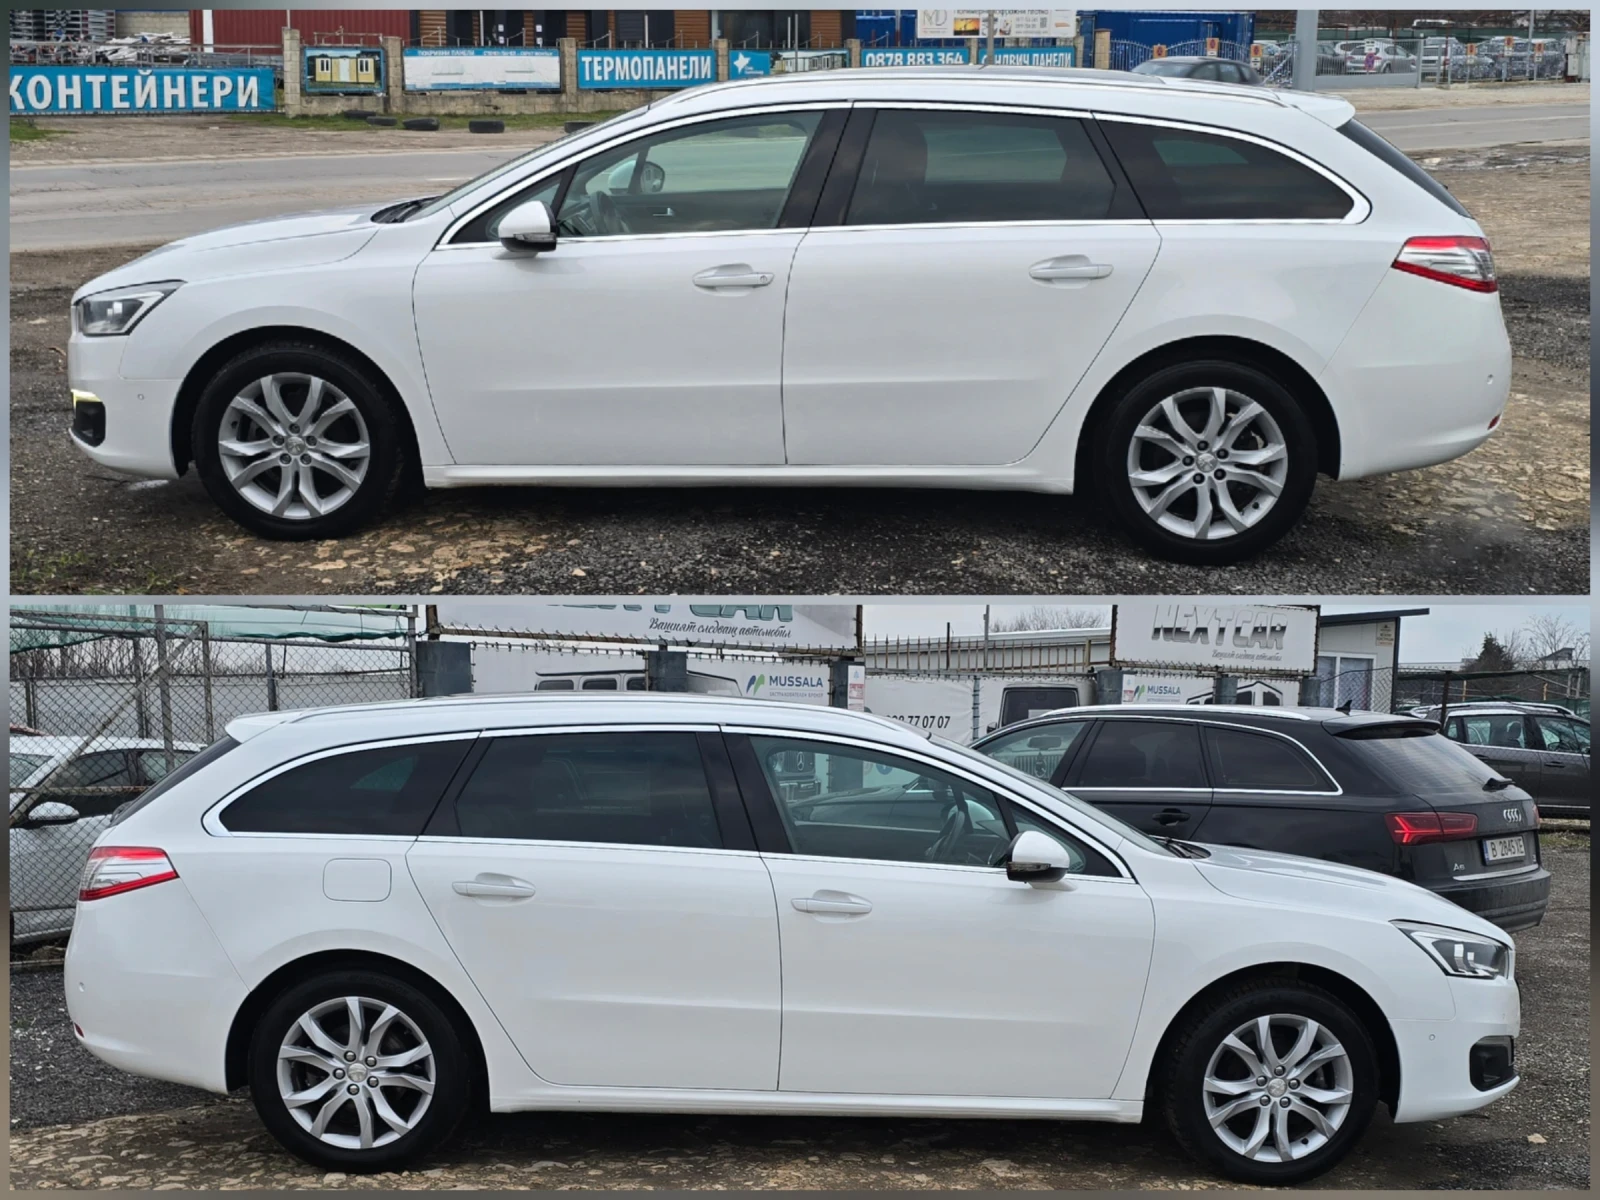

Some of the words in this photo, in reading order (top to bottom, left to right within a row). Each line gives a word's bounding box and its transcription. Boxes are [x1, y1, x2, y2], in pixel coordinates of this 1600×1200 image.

[865, 52, 903, 66] 0878
[1032, 52, 1072, 67] ПАНЕЛИ
[581, 56, 712, 81] ТЕРМОПАНЕЛИ
[10, 69, 260, 110] КОНТЕЙНЕРИ
[649, 617, 697, 633] Вашият
[697, 620, 738, 637] следващ
[739, 625, 793, 638] автомобил
[769, 675, 824, 687] MUSSALA
[1147, 685, 1181, 695] MUSSALA
[922, 715, 936, 728] 07
[937, 715, 951, 728] 07
[1490, 841, 1498, 858] B
